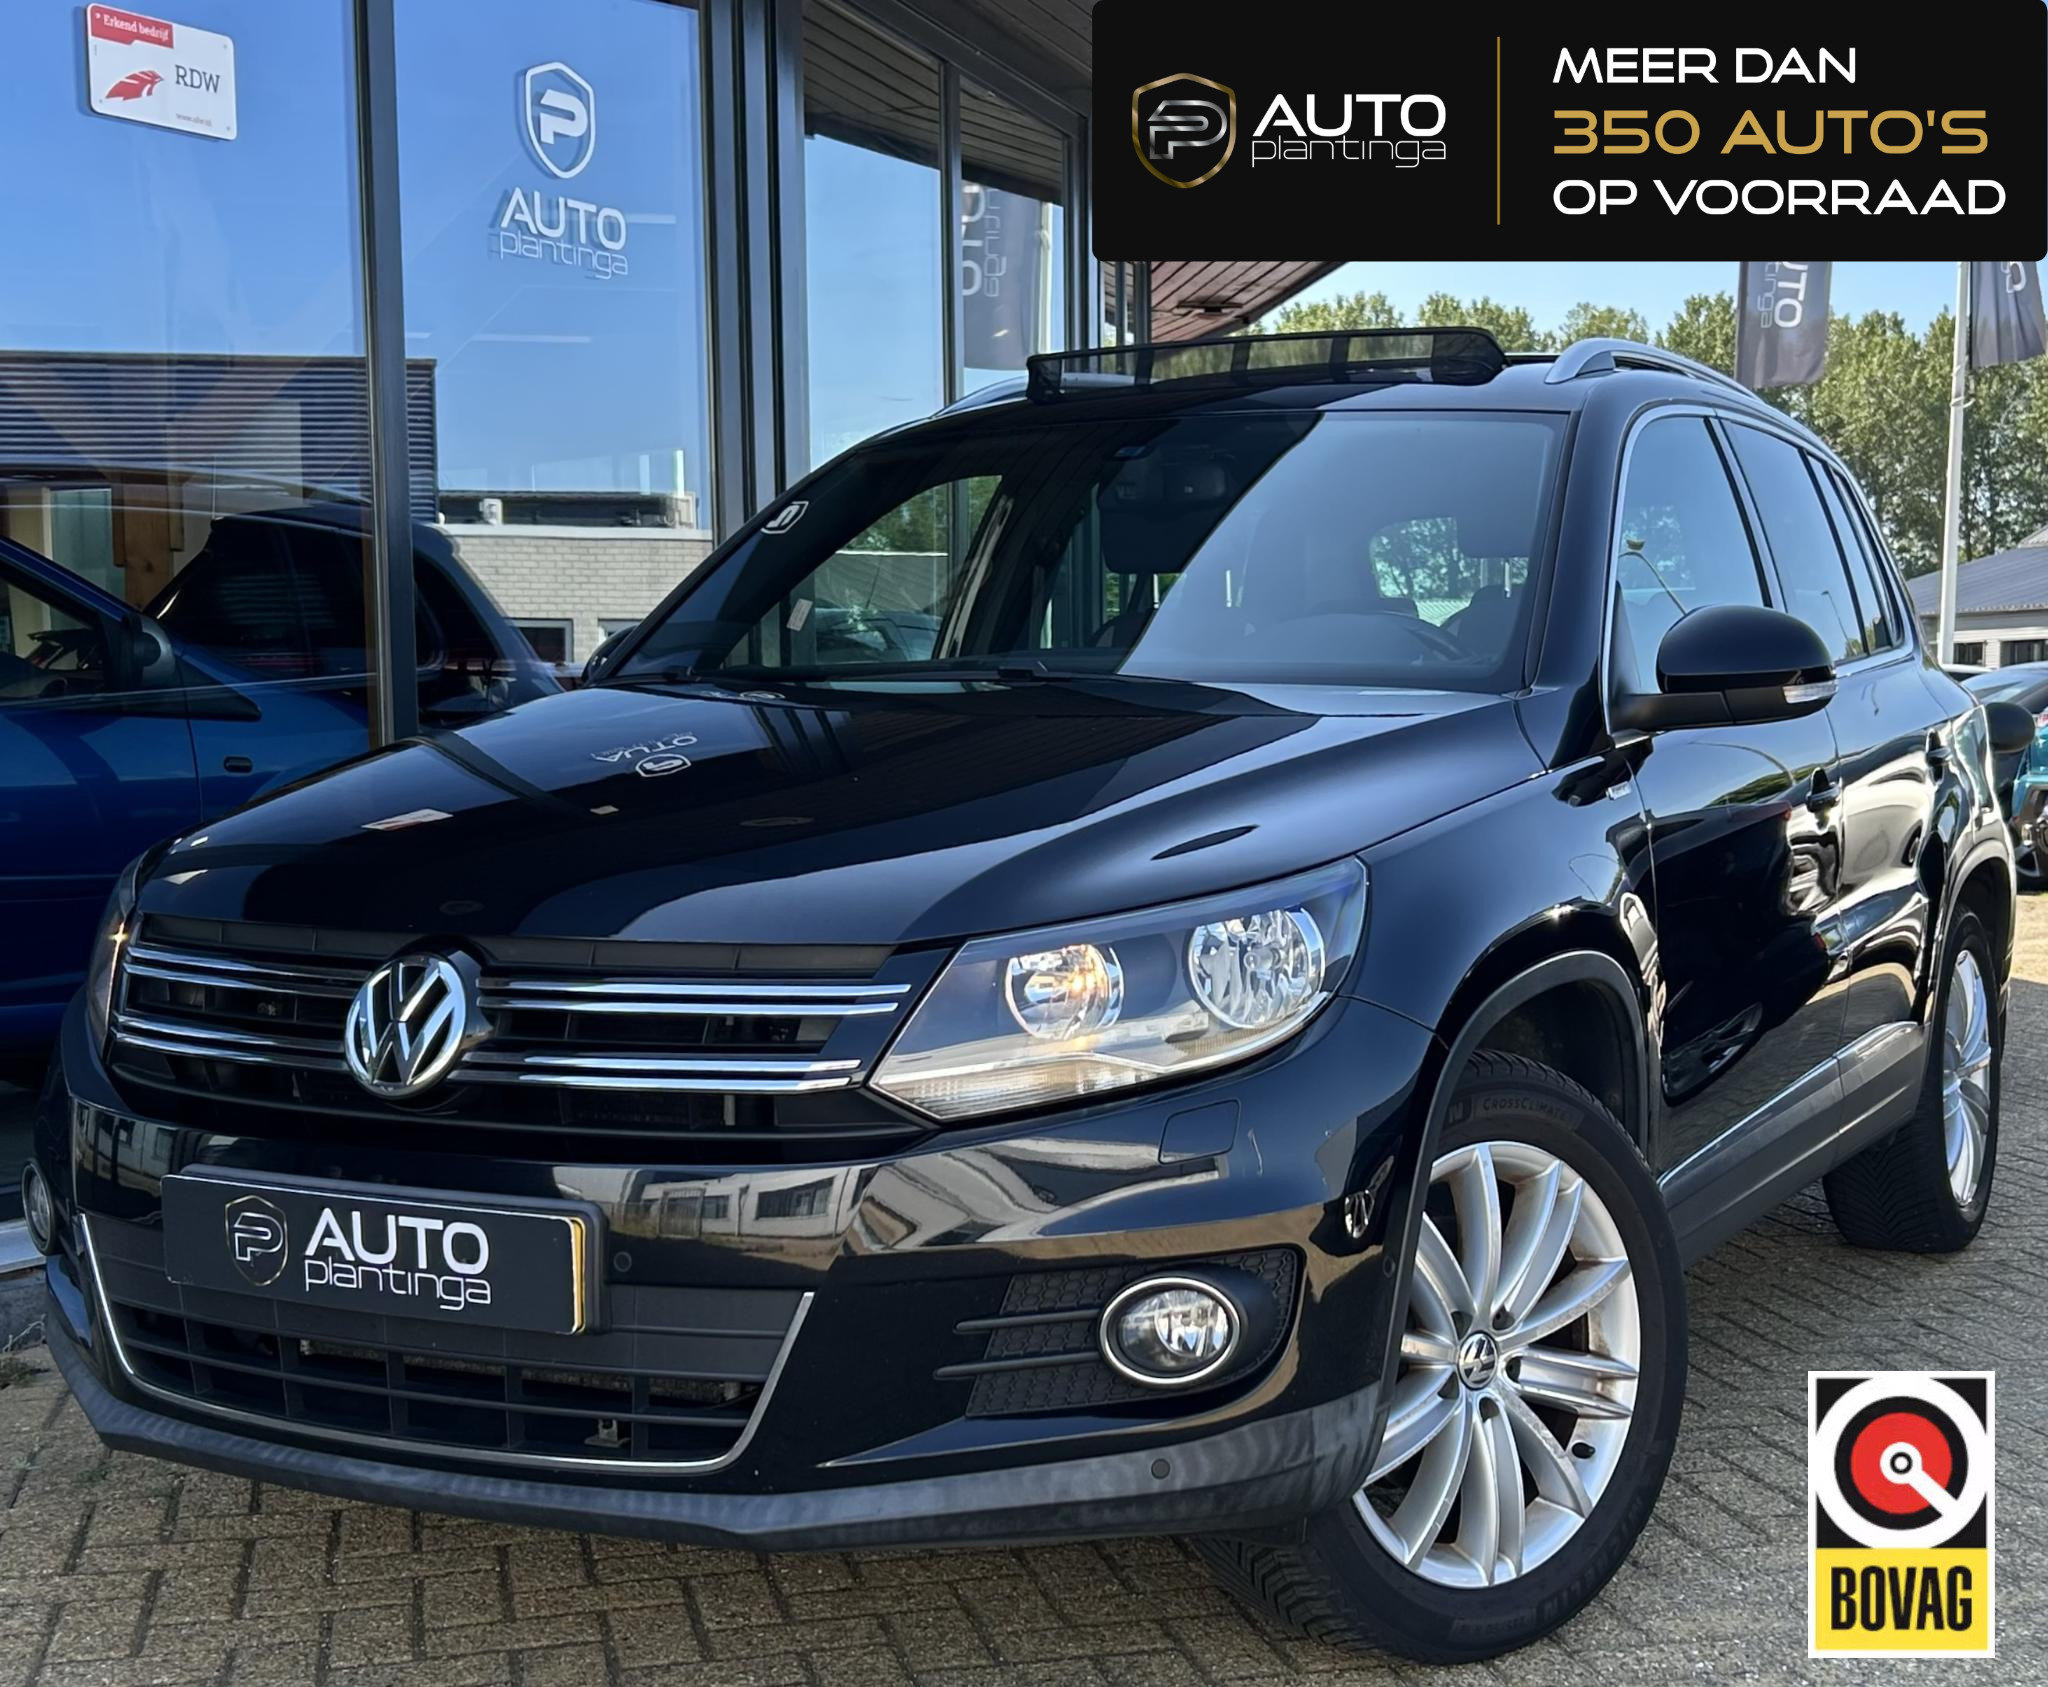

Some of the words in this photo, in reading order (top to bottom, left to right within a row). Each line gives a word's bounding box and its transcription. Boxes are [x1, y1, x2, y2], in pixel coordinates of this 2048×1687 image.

[103, 14, 138, 33] Erkend
[138, 22, 169, 41] bedrijf
[175, 64, 220, 94] RDW
[501, 187, 627, 251] AUTO
[500, 230, 629, 279] plantinga
[304, 1207, 490, 1275] AUTO
[304, 1255, 492, 1311] plantinga
